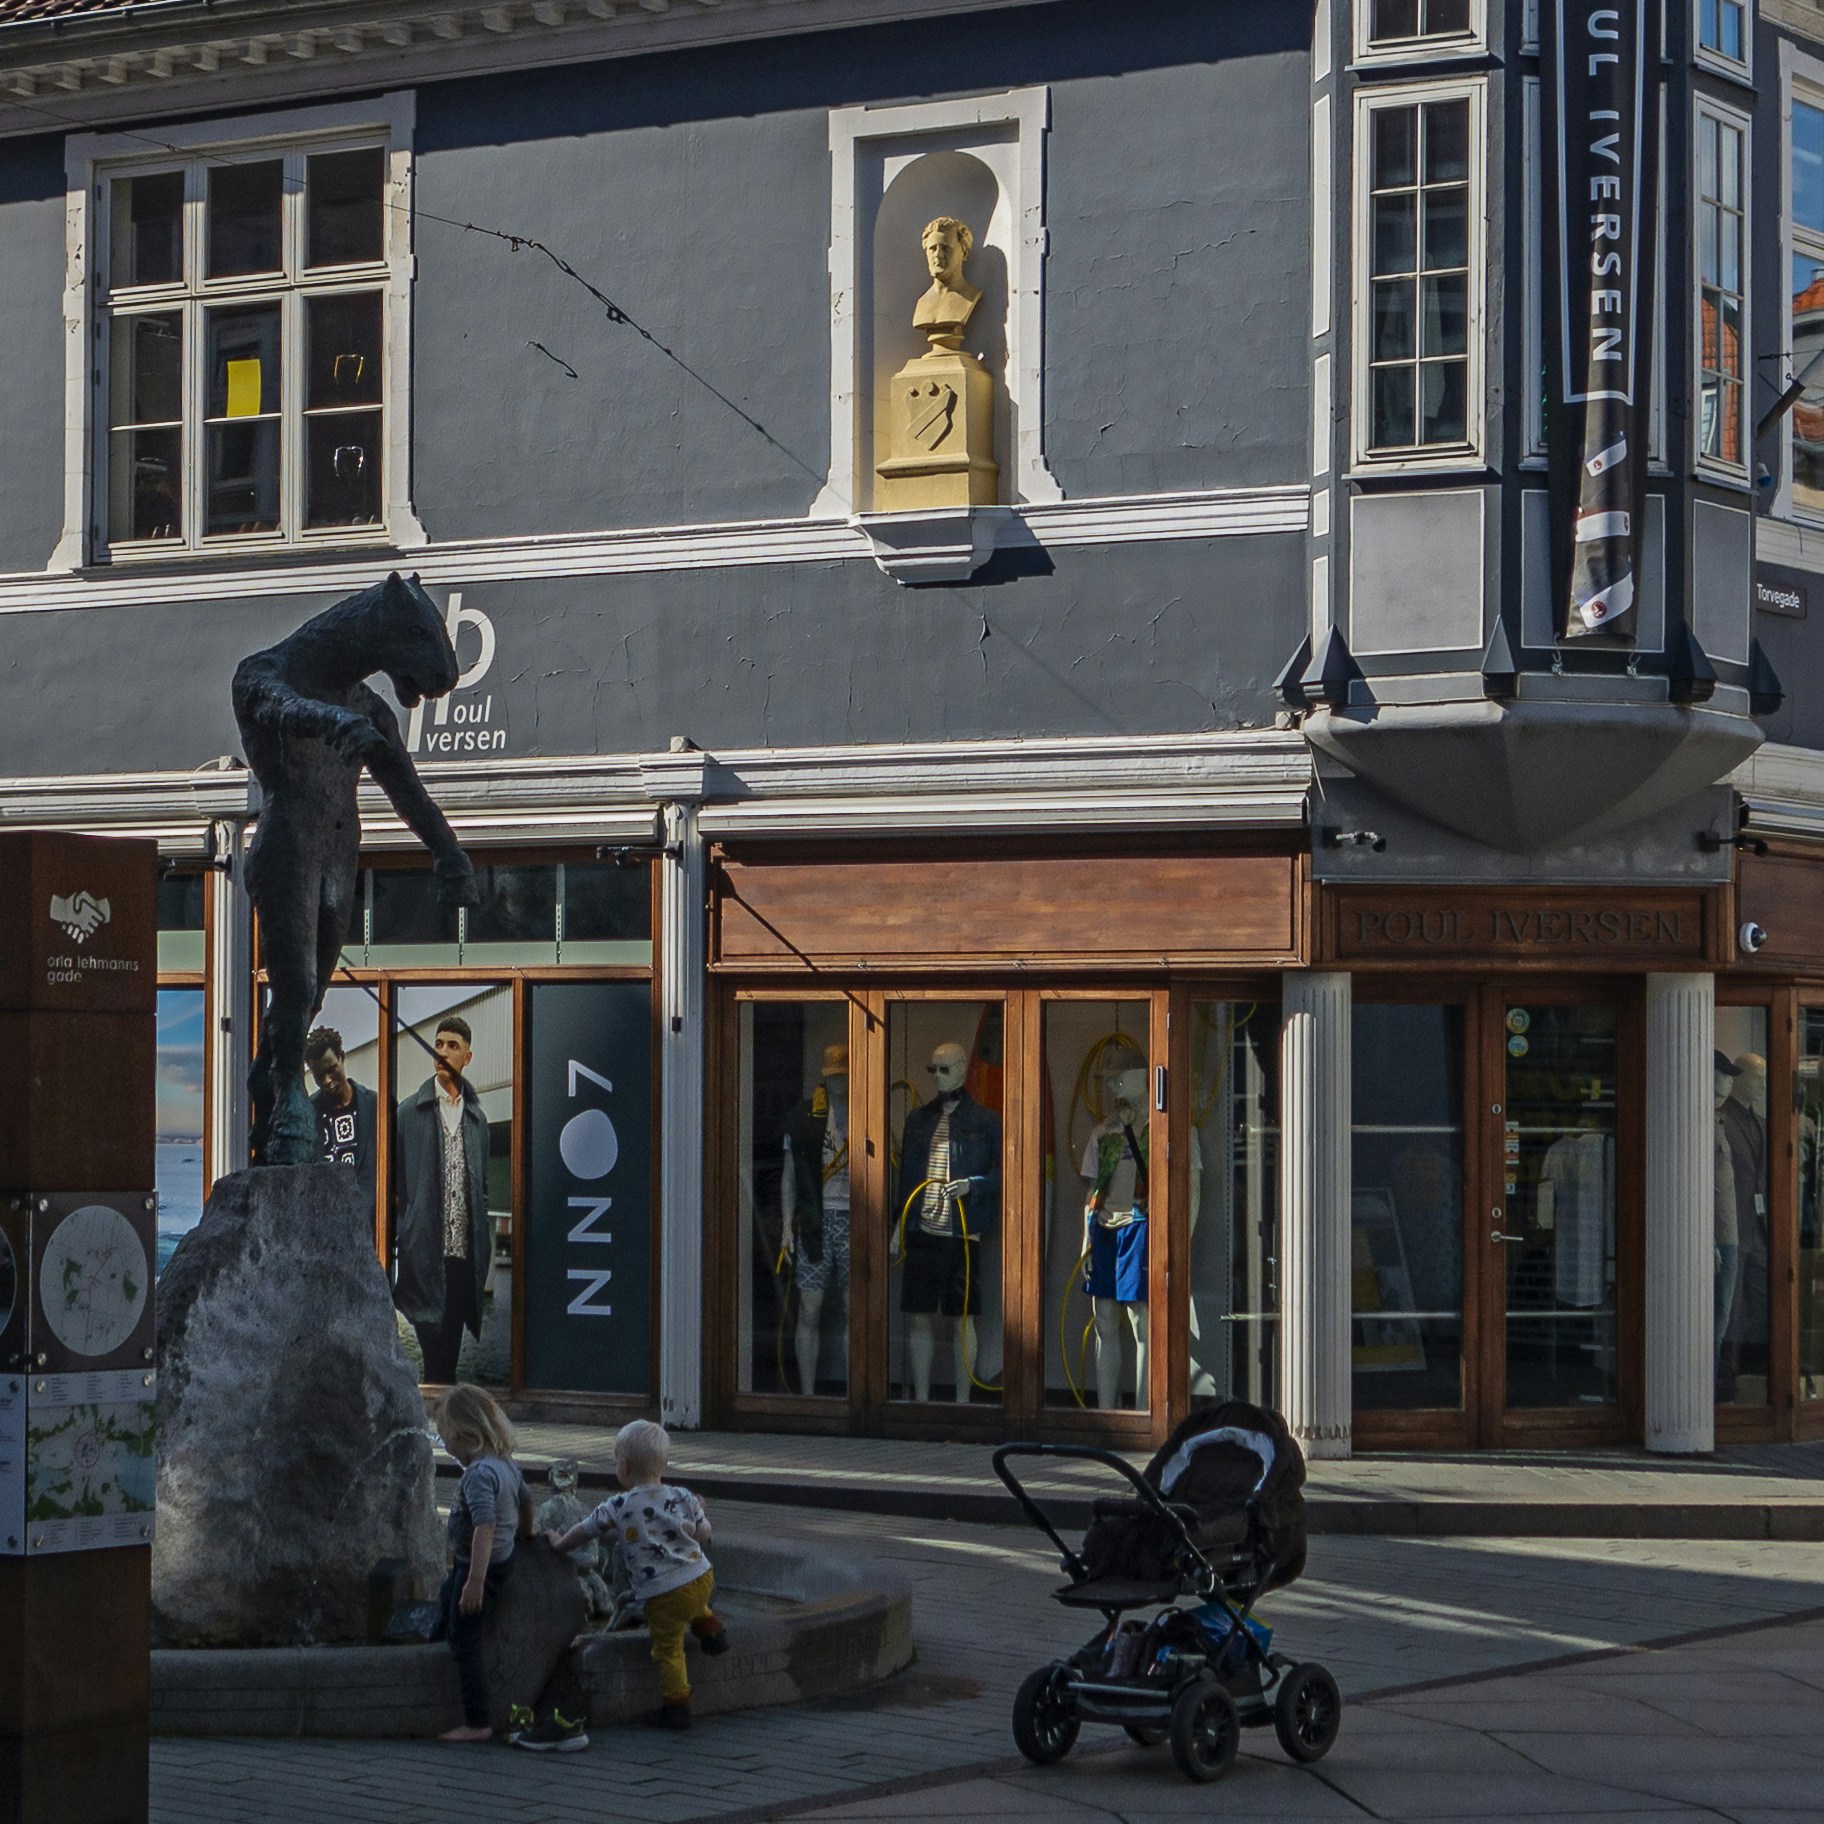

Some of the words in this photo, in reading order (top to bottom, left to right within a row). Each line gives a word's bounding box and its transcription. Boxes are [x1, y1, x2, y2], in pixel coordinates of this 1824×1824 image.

[1589, 110, 1622, 362] IVERSEN
[1757, 583, 1800, 608] Torvegade
[1356, 910, 1475, 944] POUL
[1491, 910, 1684, 944] IVERSEN
[47, 957, 72, 968] orla
[77, 956, 139, 971] lehmanns
[47, 972, 82, 985] gade
